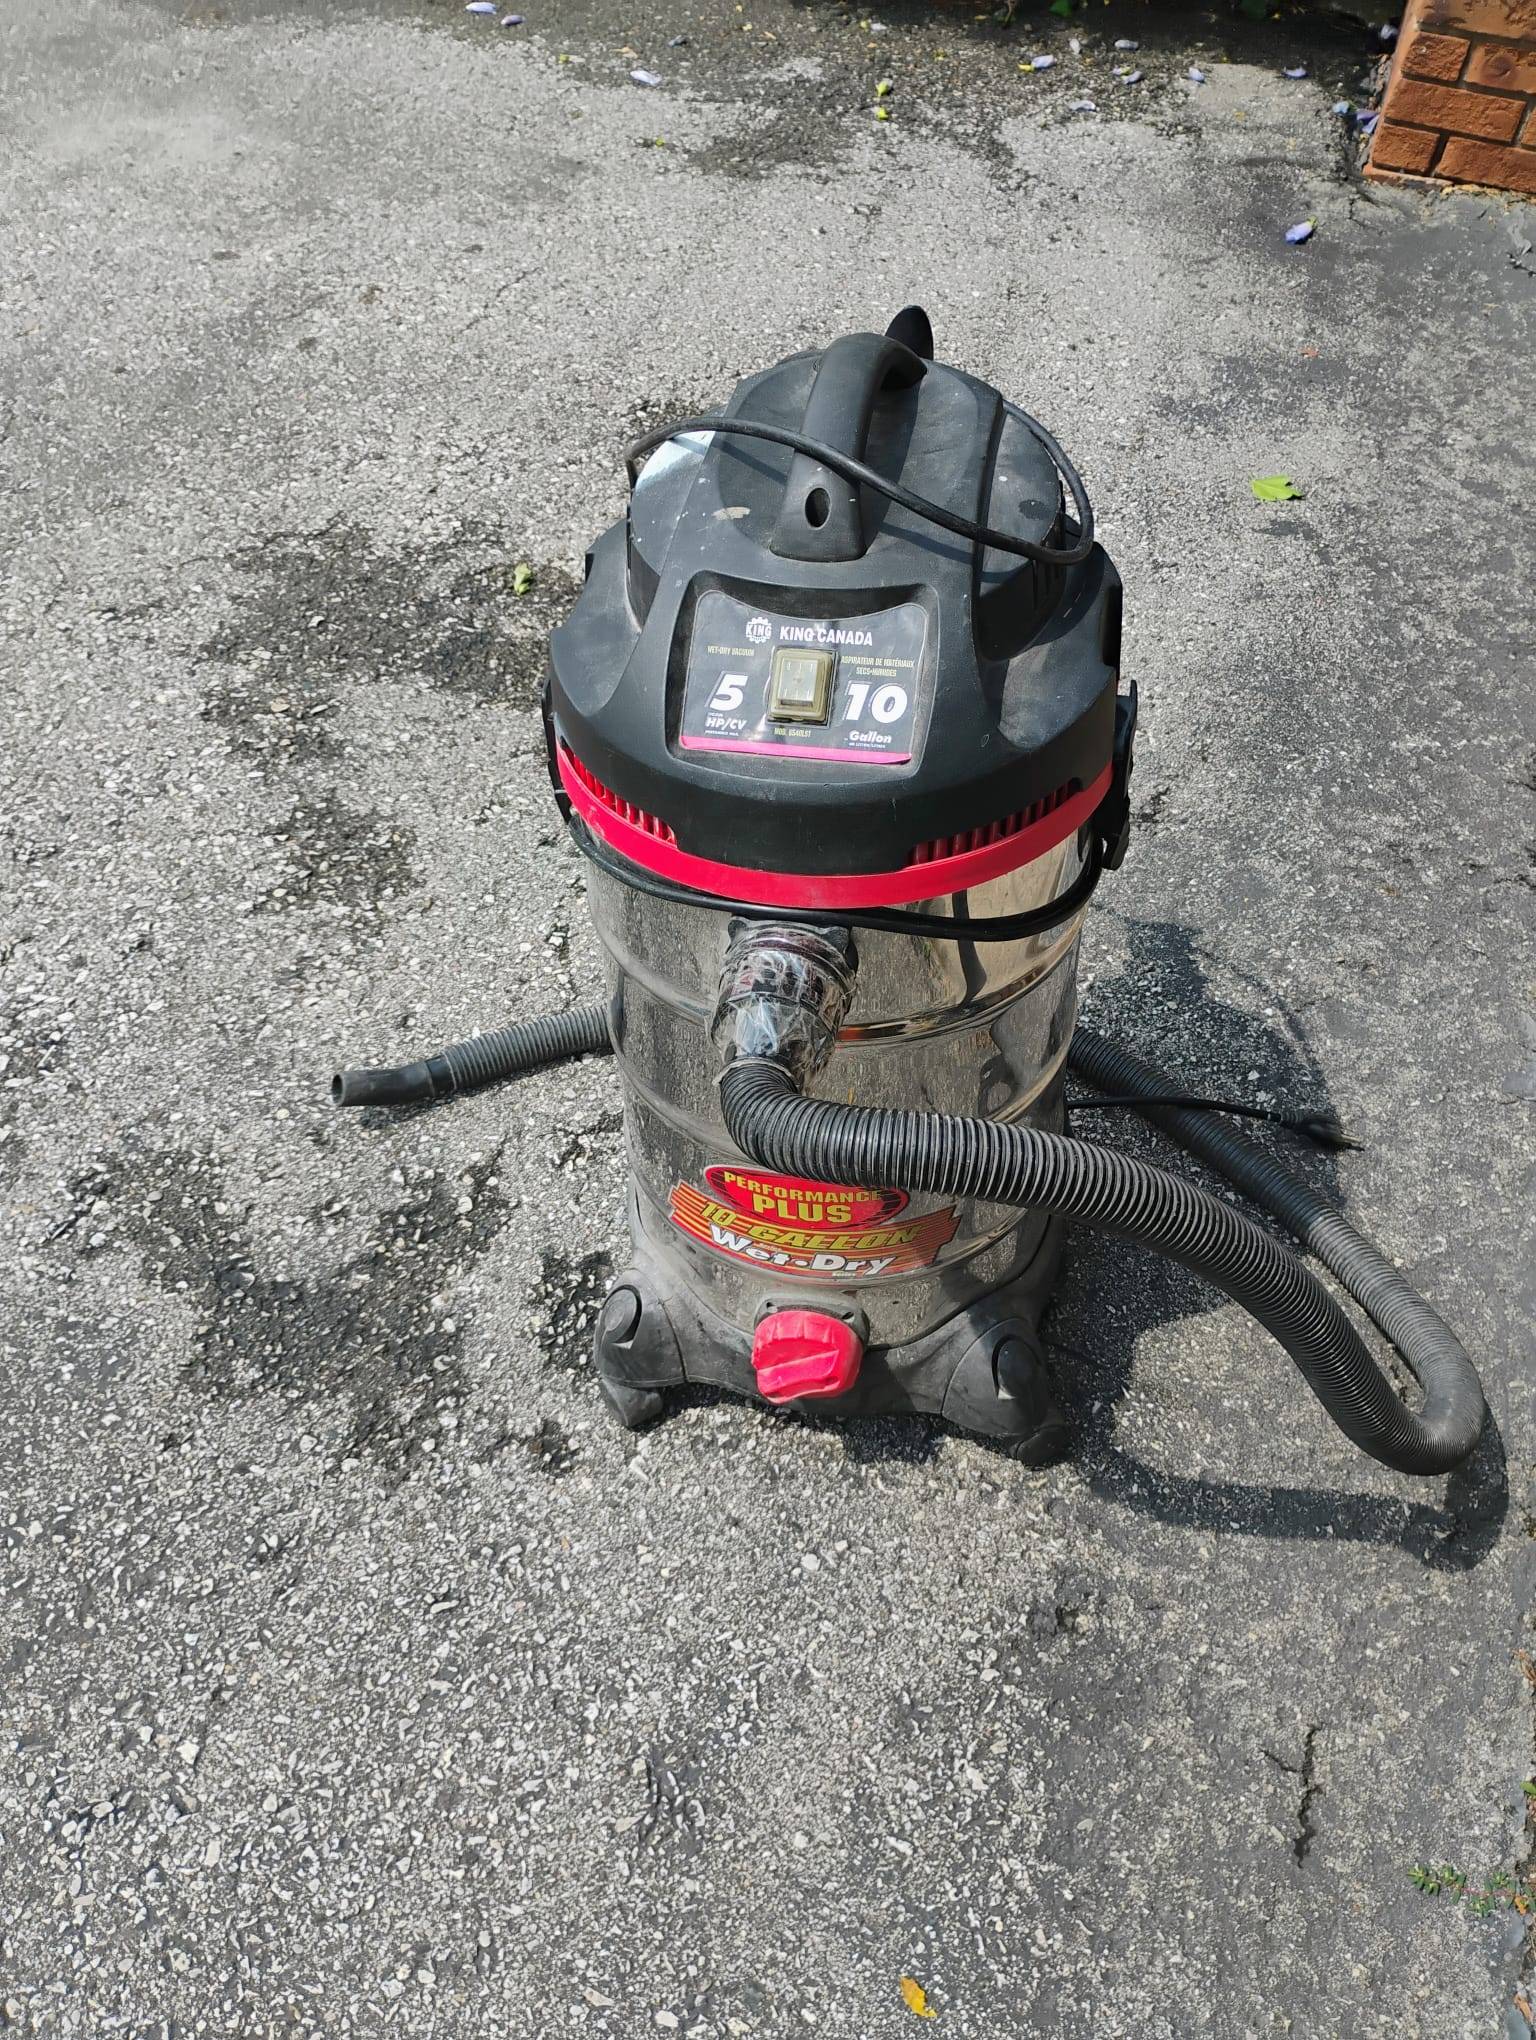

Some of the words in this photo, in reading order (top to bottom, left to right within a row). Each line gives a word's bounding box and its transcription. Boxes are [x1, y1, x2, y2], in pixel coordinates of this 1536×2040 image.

[745, 624, 772, 637] KING
[780, 626, 814, 641] KING
[817, 628, 873, 646] CANADA
[709, 673, 749, 711] 5
[845, 684, 908, 724] 10
[705, 715, 747, 731] HP/CV
[849, 730, 892, 743] Gallon
[723, 1170, 881, 1204] PERFORMANCE
[753, 1194, 852, 1223] PLUS
[701, 1202, 737, 1226] 10
[749, 1223, 922, 1249] GALLON
